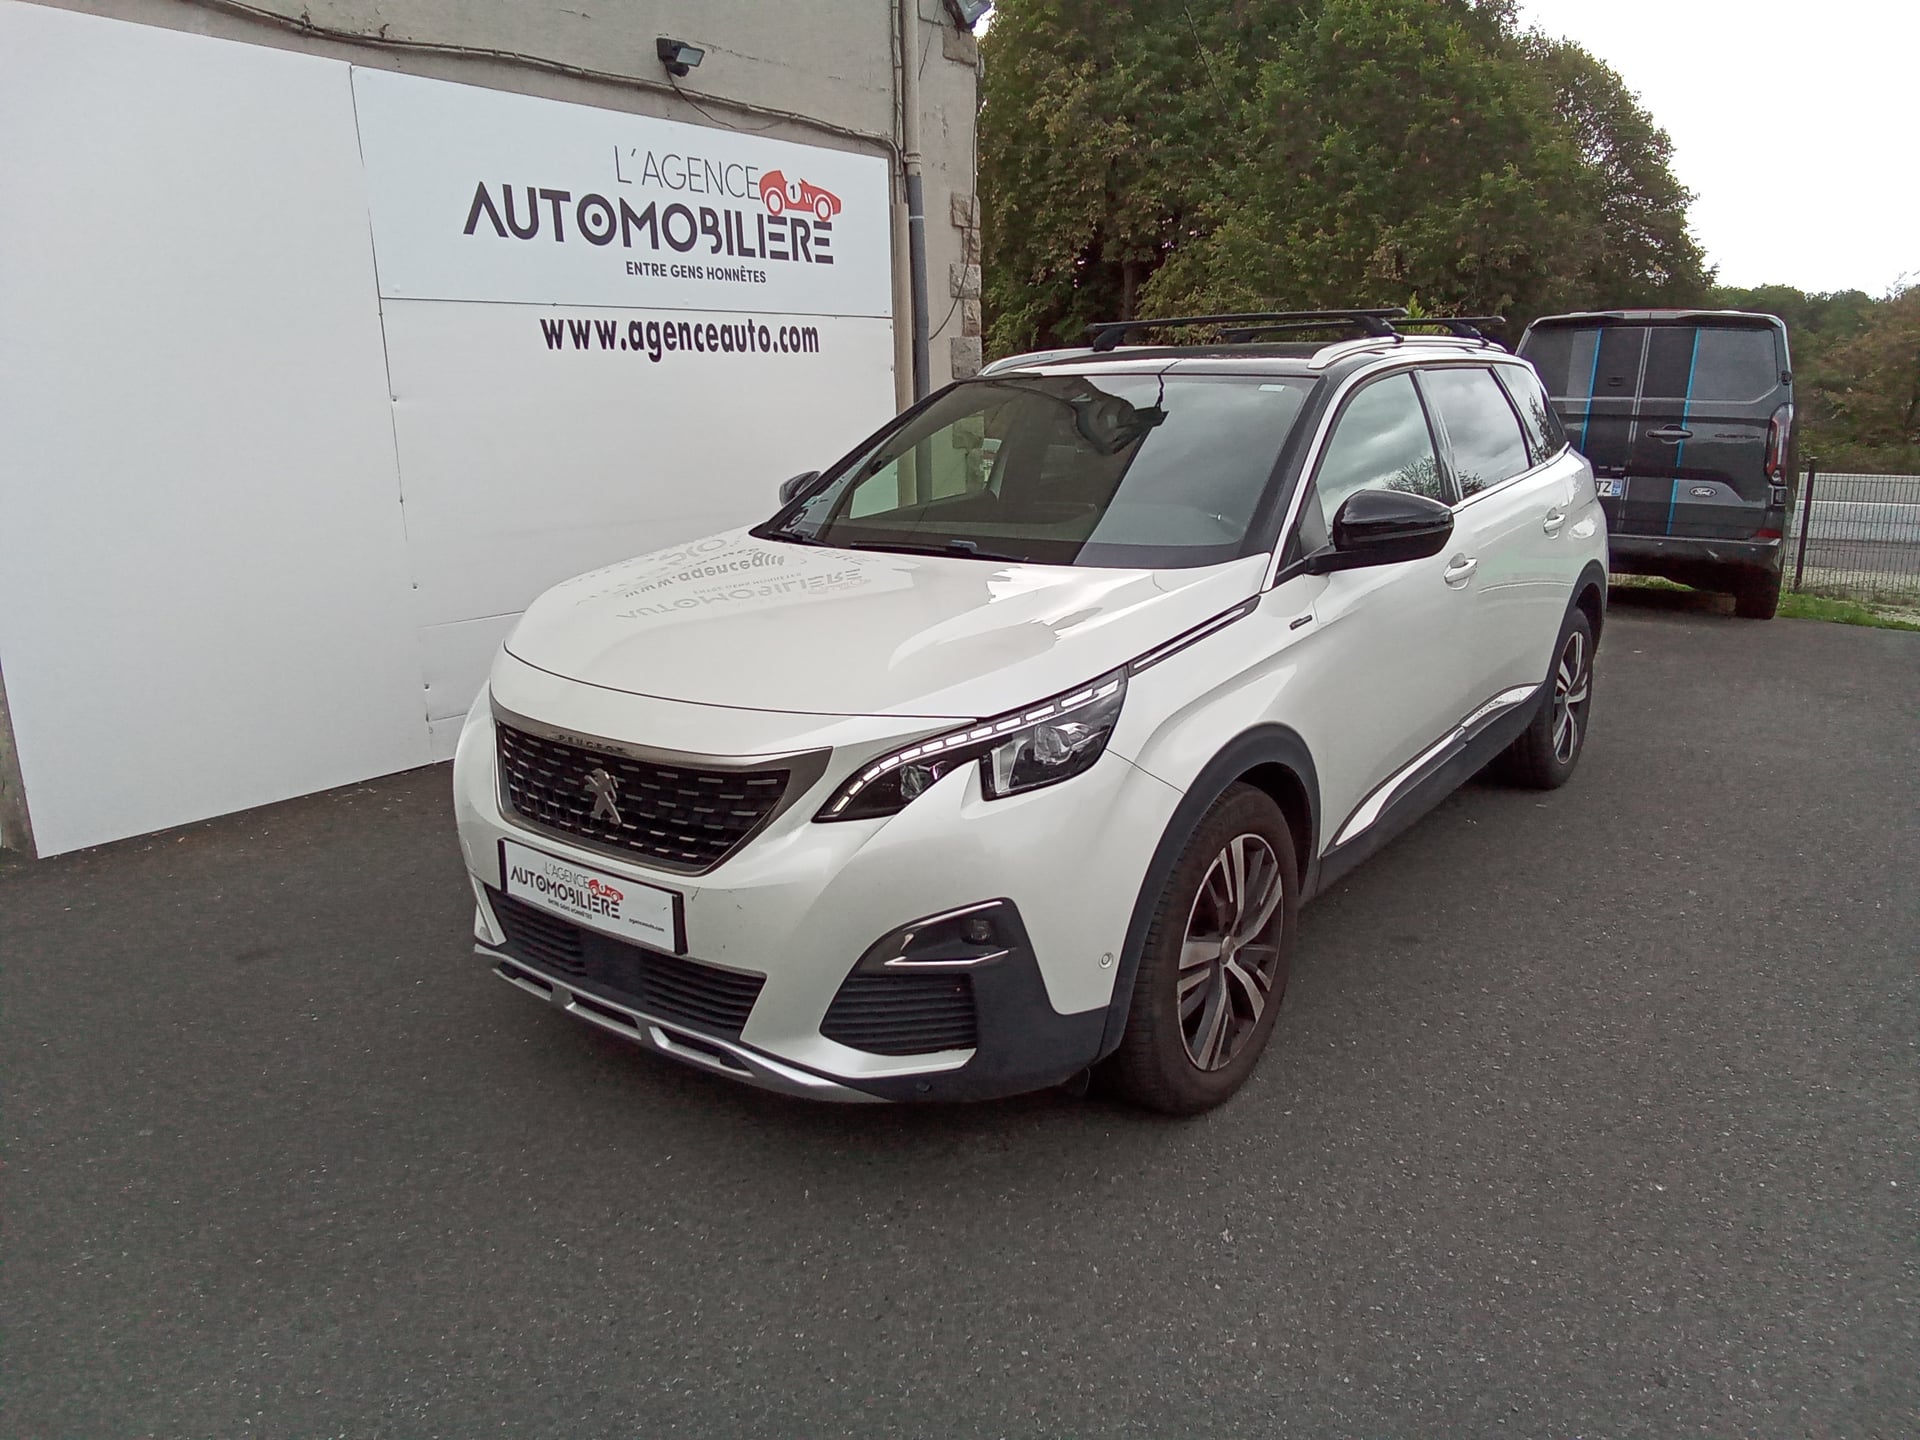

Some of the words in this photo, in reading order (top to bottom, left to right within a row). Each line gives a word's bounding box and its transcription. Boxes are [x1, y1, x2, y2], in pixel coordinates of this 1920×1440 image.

[614, 145, 760, 200] L'AGENCE
[463, 181, 834, 265] AUTOMOBILIERE
[626, 261, 667, 277] ENTRE
[670, 264, 704, 279] GENS
[706, 265, 767, 283] HONNÊTES
[540, 318, 820, 363] www.agenceauto.com
